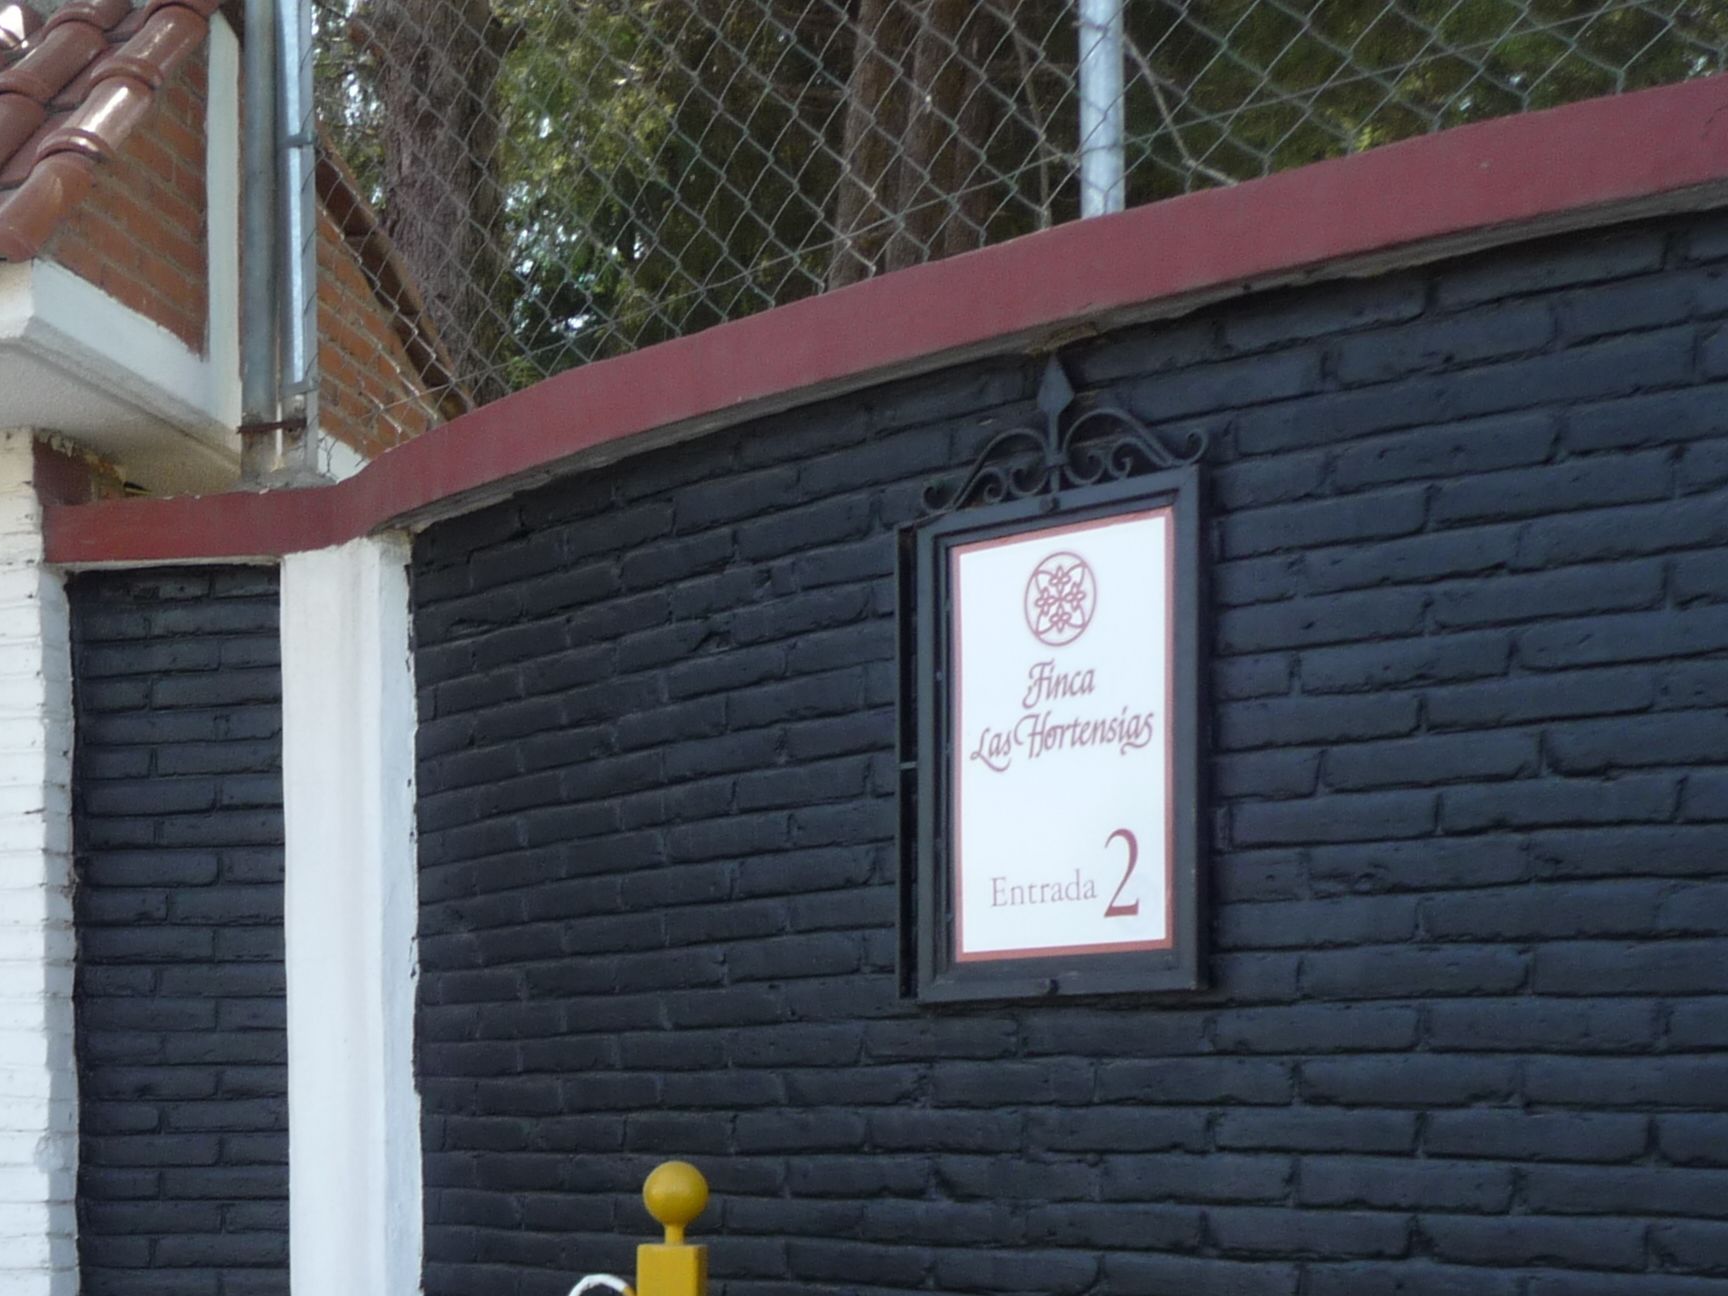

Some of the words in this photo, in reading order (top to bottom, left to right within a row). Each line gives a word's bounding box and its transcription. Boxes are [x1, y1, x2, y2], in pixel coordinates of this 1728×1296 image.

[1022, 658, 1095, 709] Finca
[970, 727, 1013, 772] Las
[1014, 706, 1155, 759] Hortensias
[990, 868, 1098, 908] Entrada
[1103, 828, 1140, 918] 2
